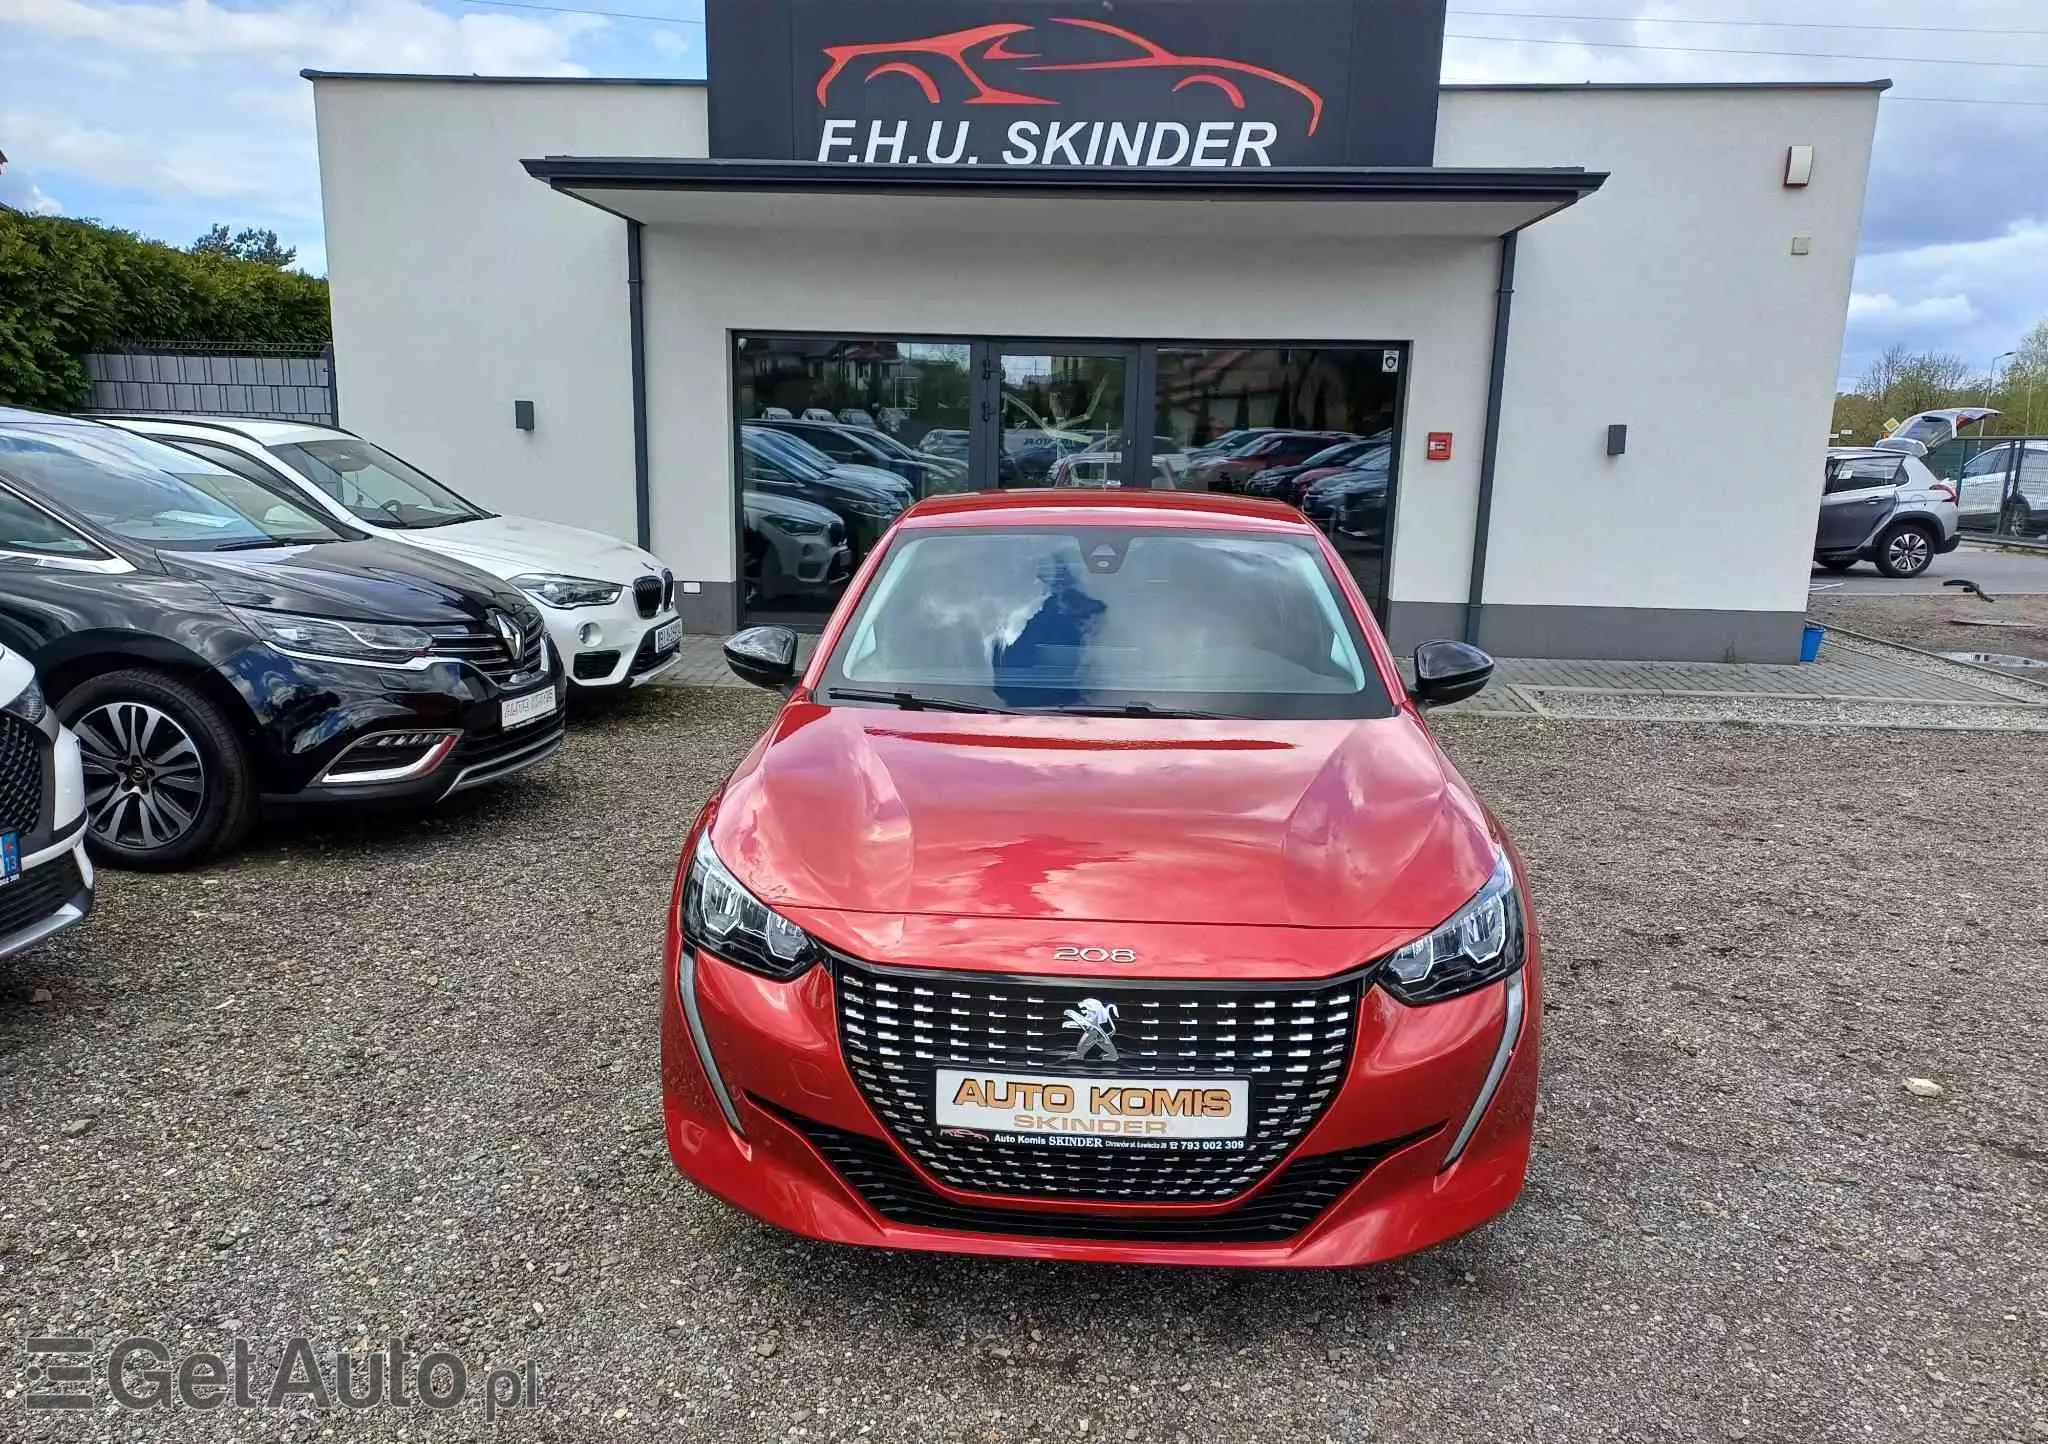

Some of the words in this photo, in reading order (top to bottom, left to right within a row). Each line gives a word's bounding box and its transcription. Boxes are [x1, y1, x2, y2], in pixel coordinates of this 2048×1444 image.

[817, 119, 977, 164] F.H.U.
[1002, 120, 1278, 167] SKINDER
[1053, 946, 1136, 963] 208
[952, 1078, 1074, 1113] AUTO
[1090, 1086, 1231, 1118] KOMIS
[1013, 1114, 1169, 1135] SKINDER
[994, 1133, 1016, 1143] Auto
[1017, 1135, 1046, 1145] Komis
[1048, 1136, 1103, 1148] SKINDER
[1181, 1141, 1200, 1150] 793
[1202, 1141, 1222, 1150] 002
[1224, 1140, 1244, 1150] 309
